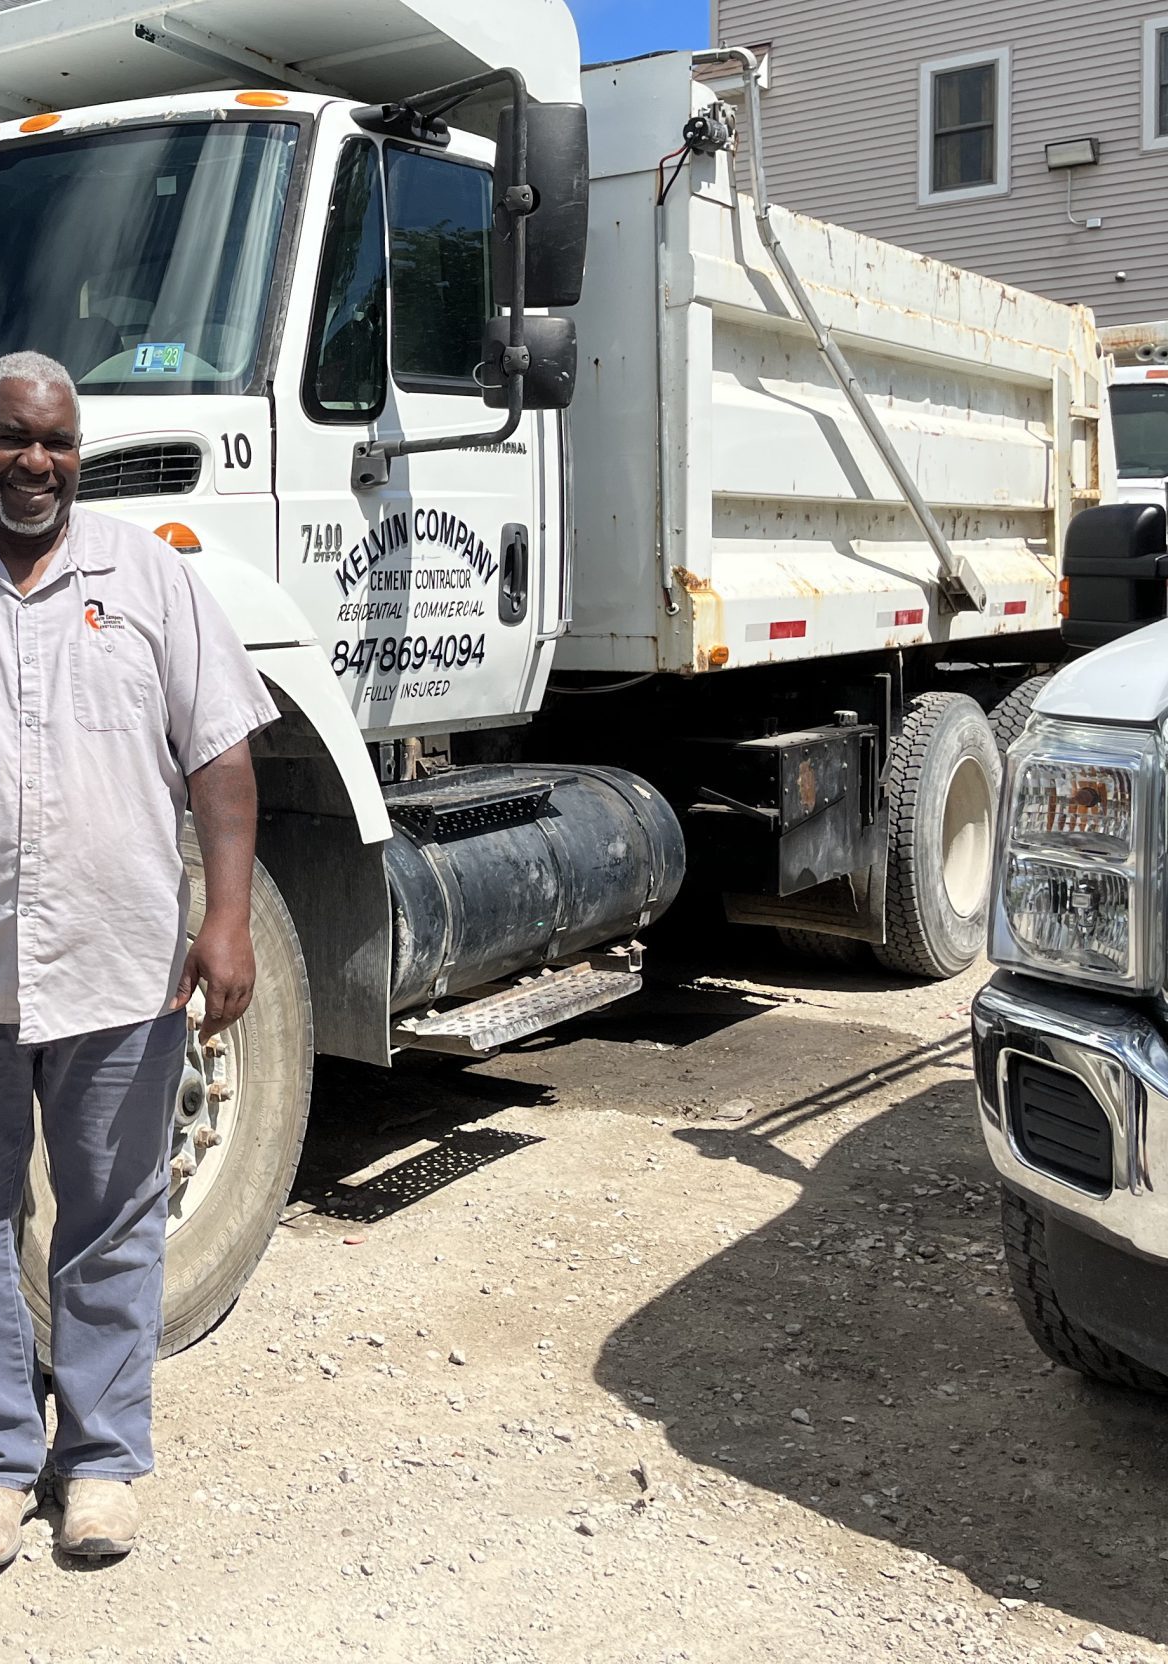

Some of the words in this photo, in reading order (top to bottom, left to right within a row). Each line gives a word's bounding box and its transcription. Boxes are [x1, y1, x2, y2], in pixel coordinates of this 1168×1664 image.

[142, 348, 148, 366] 1
[164, 347, 179, 366] 23
[221, 432, 252, 470] 10
[301, 523, 342, 564] 7400
[335, 512, 409, 598] KELVIN
[414, 508, 499, 585] COMPANY
[370, 570, 412, 591] CEMENT
[415, 568, 471, 590] CONTRACTOR
[337, 602, 403, 622] RESIDENTIAL
[413, 600, 485, 619] COMMERCIAL
[364, 684, 397, 703] FULLY
[400, 679, 451, 698] INSURED
